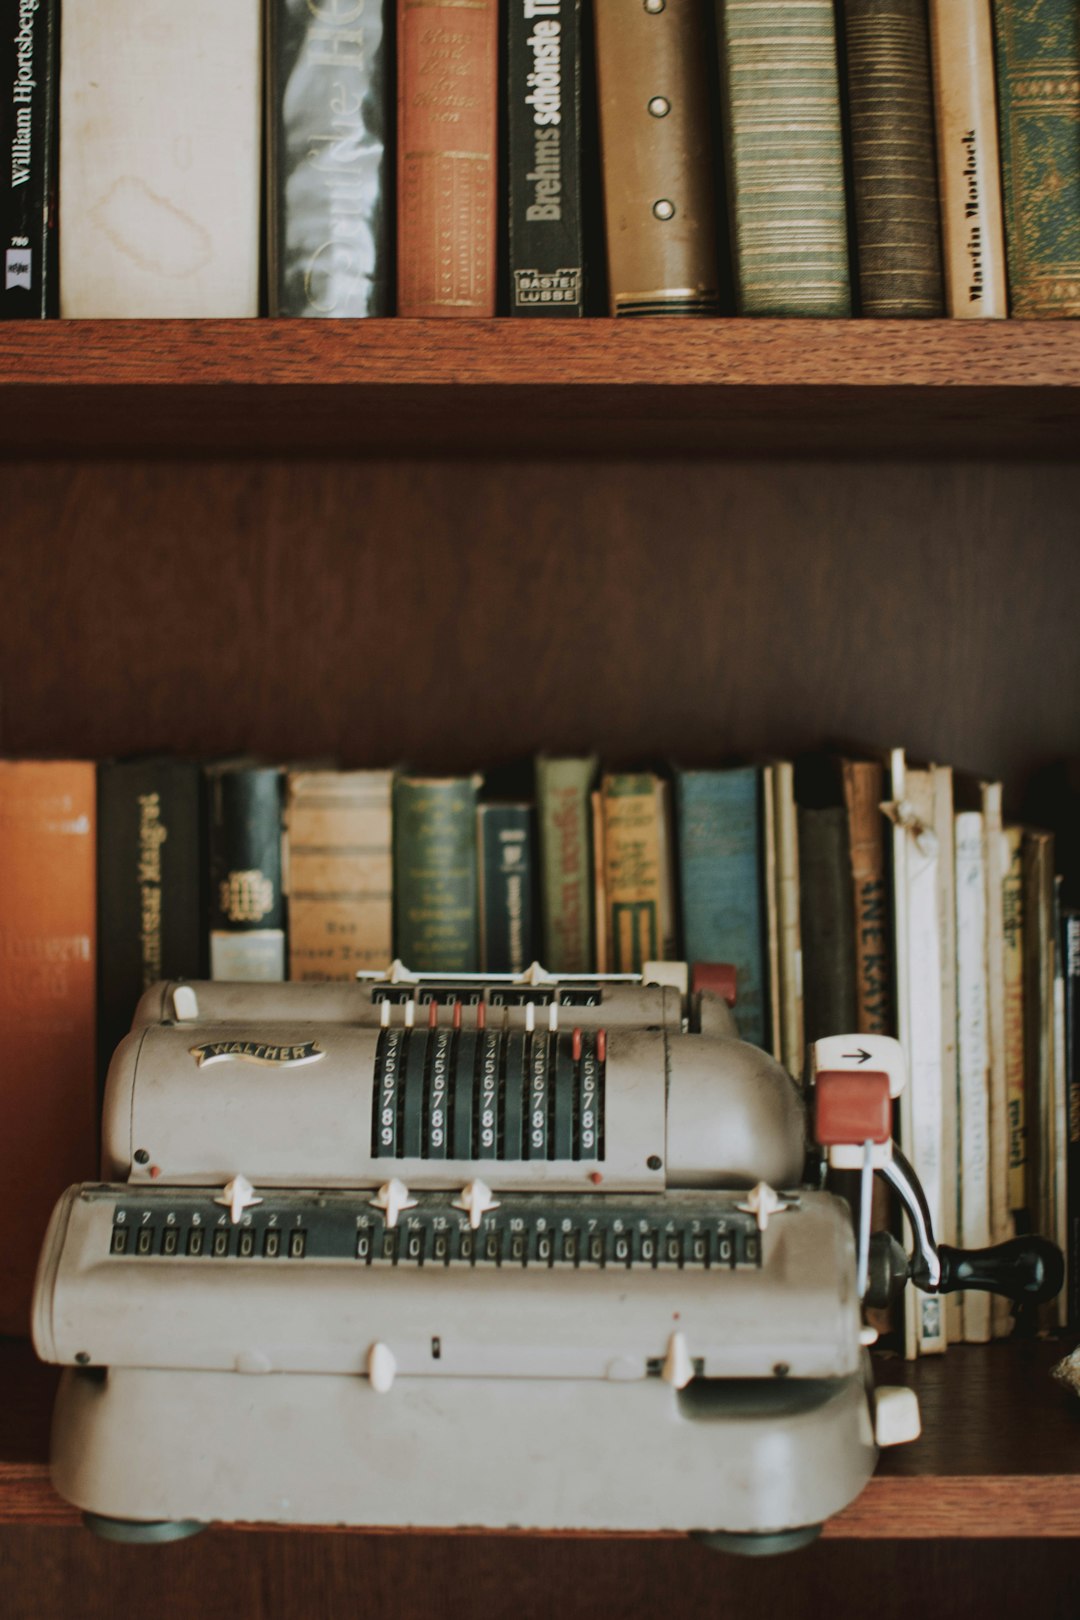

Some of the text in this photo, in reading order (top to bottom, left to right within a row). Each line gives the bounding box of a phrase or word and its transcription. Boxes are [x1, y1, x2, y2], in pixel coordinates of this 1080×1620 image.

[525, 19, 561, 126] schönste
[11, 107, 32, 188] William
[526, 128, 561, 221] Brehms
[961, 129, 984, 303] Martin Morlock
[520, 277, 576, 288] BASTEI
[211, 1043, 306, 1060] WALTHER
